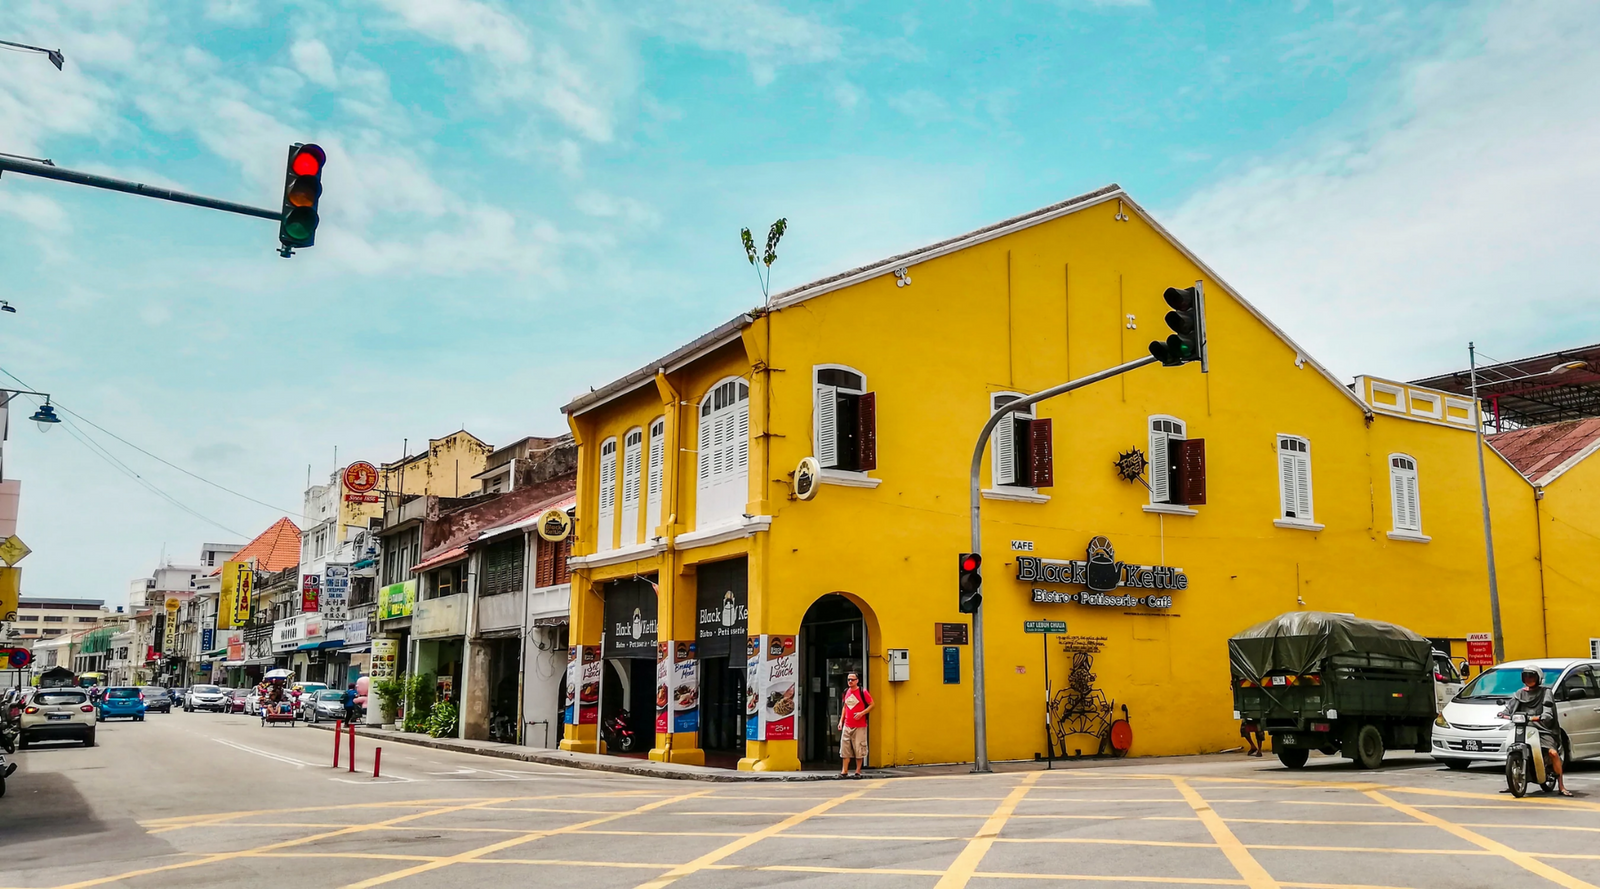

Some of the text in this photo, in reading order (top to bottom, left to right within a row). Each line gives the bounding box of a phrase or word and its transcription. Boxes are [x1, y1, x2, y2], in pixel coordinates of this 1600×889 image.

[1011, 541, 1033, 550] KAFE
[304, 576, 318, 585] 4D
[1016, 556, 1188, 591] Black Kettle
[1033, 589, 1173, 608] Bistro Patisserie Café
[699, 607, 721, 624] Black
[615, 622, 632, 636] Black
[700, 627, 745, 638] Bistro Patisserie
[774, 656, 789, 670] Set
[769, 663, 793, 681] Lunch
